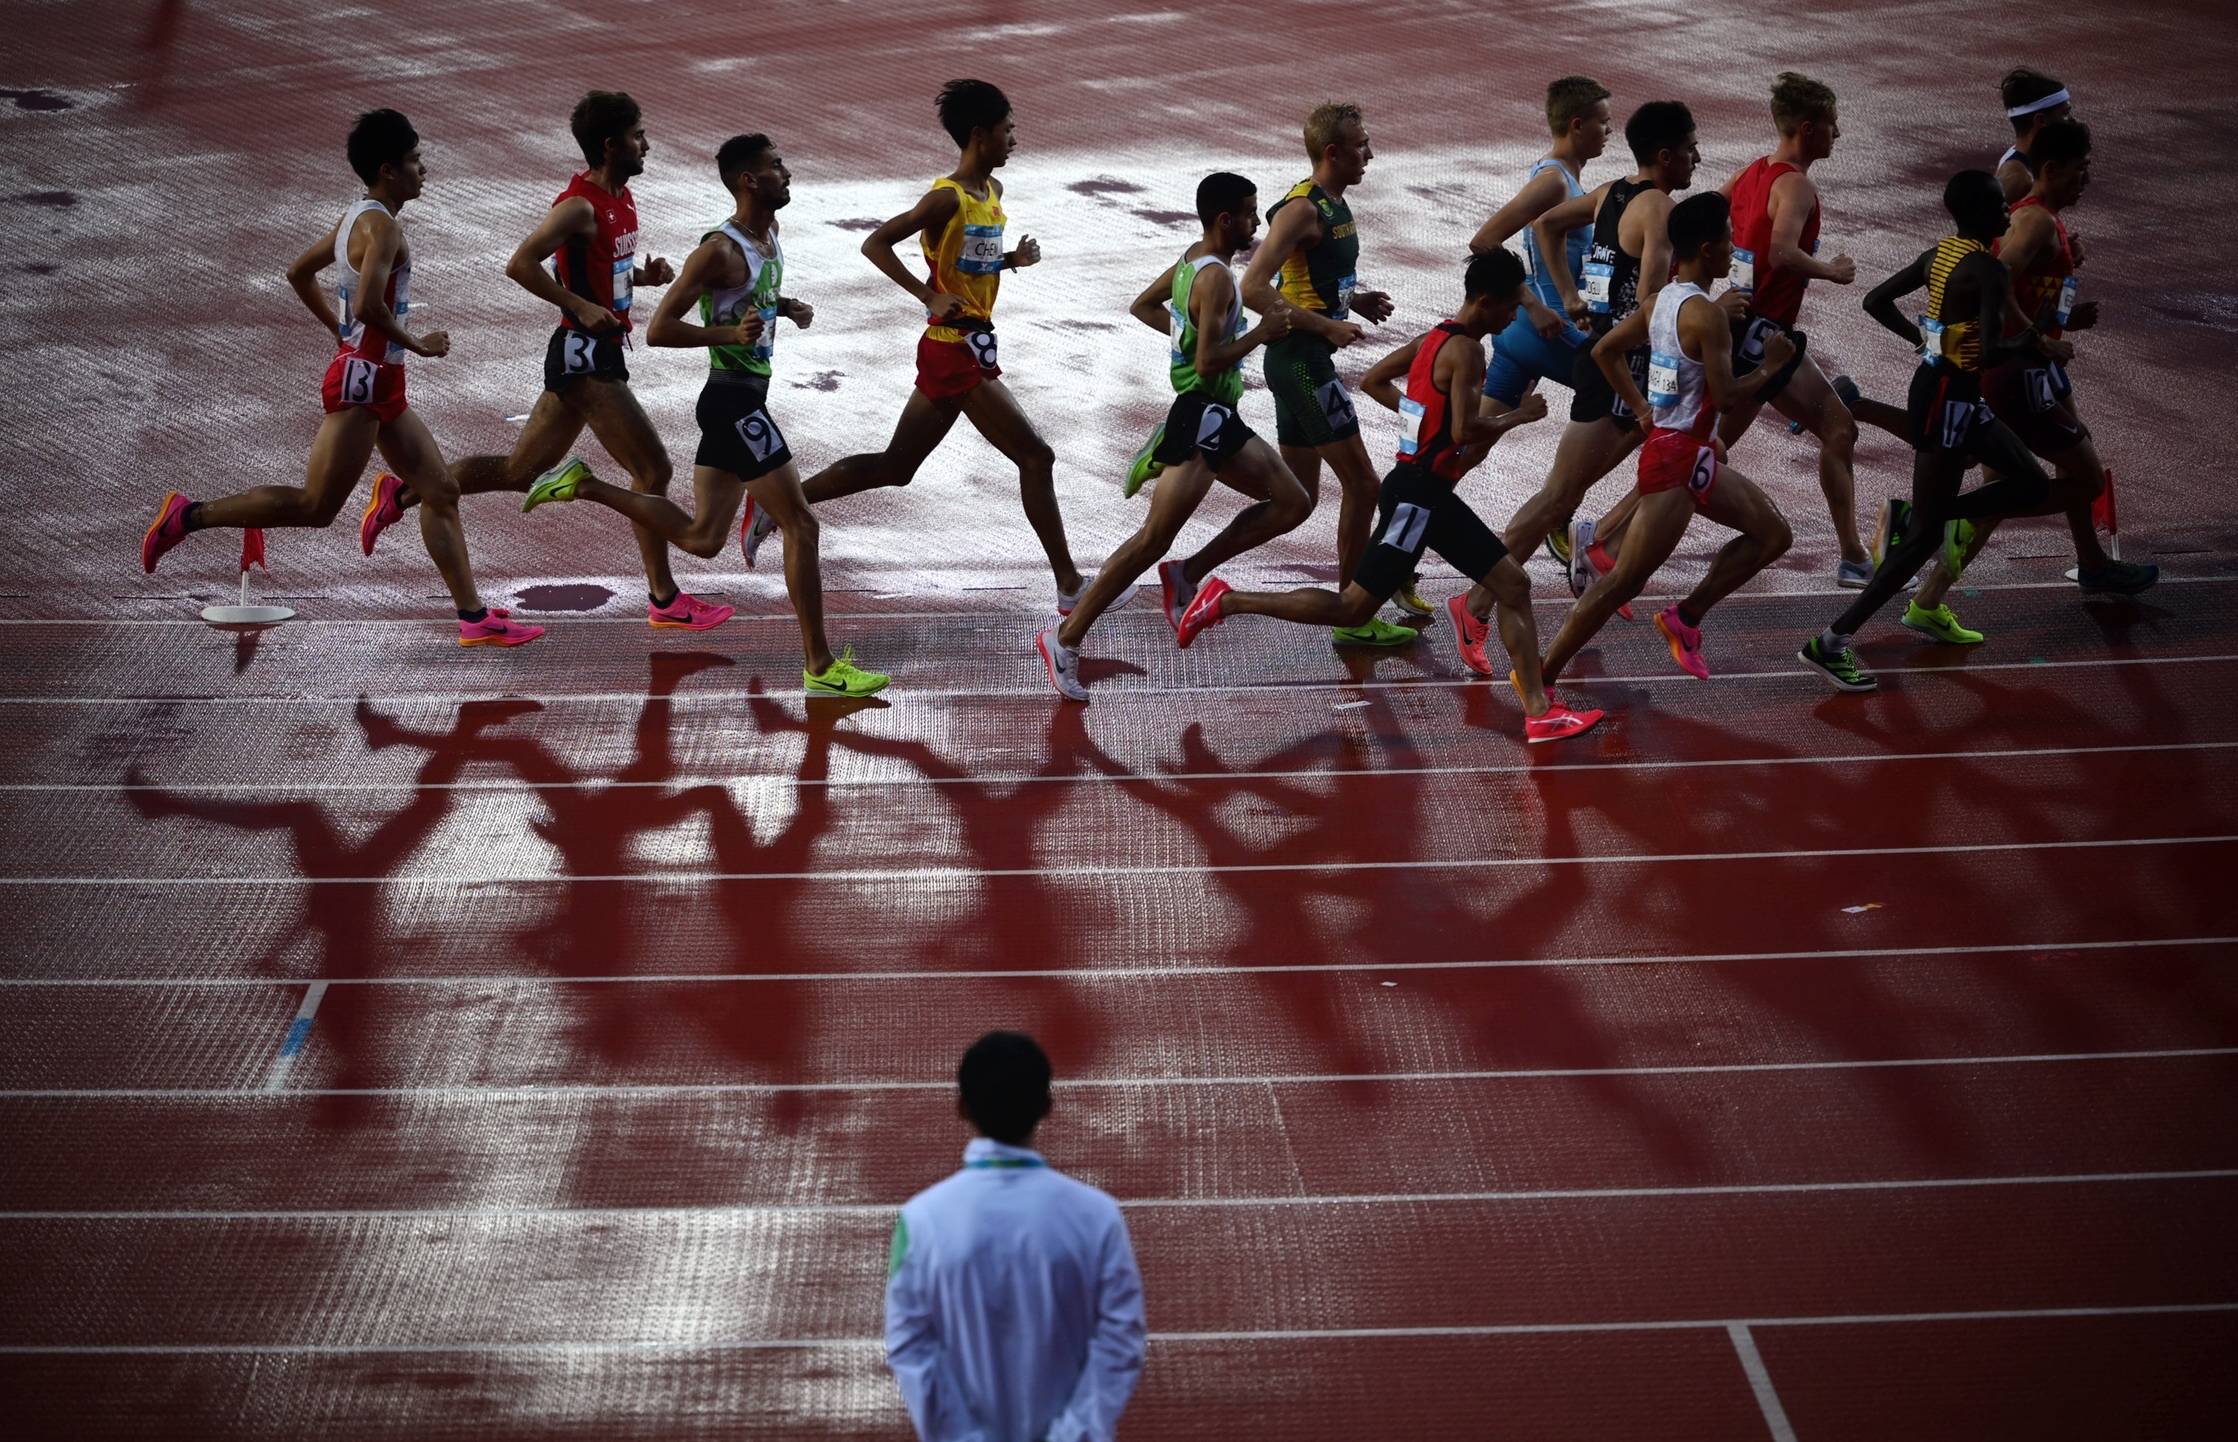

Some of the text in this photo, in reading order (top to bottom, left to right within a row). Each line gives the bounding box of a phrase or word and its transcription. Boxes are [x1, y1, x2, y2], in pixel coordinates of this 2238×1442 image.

[569, 333, 590, 372] 3
[972, 332, 997, 368] 8
[1743, 320, 1778, 361] 5
[344, 360, 372, 402] 13
[1327, 382, 1351, 418] 4
[743, 417, 771, 455] 9
[1199, 406, 1228, 450] 2
[1693, 450, 1710, 489] 6
[1396, 507, 1418, 547] 1
